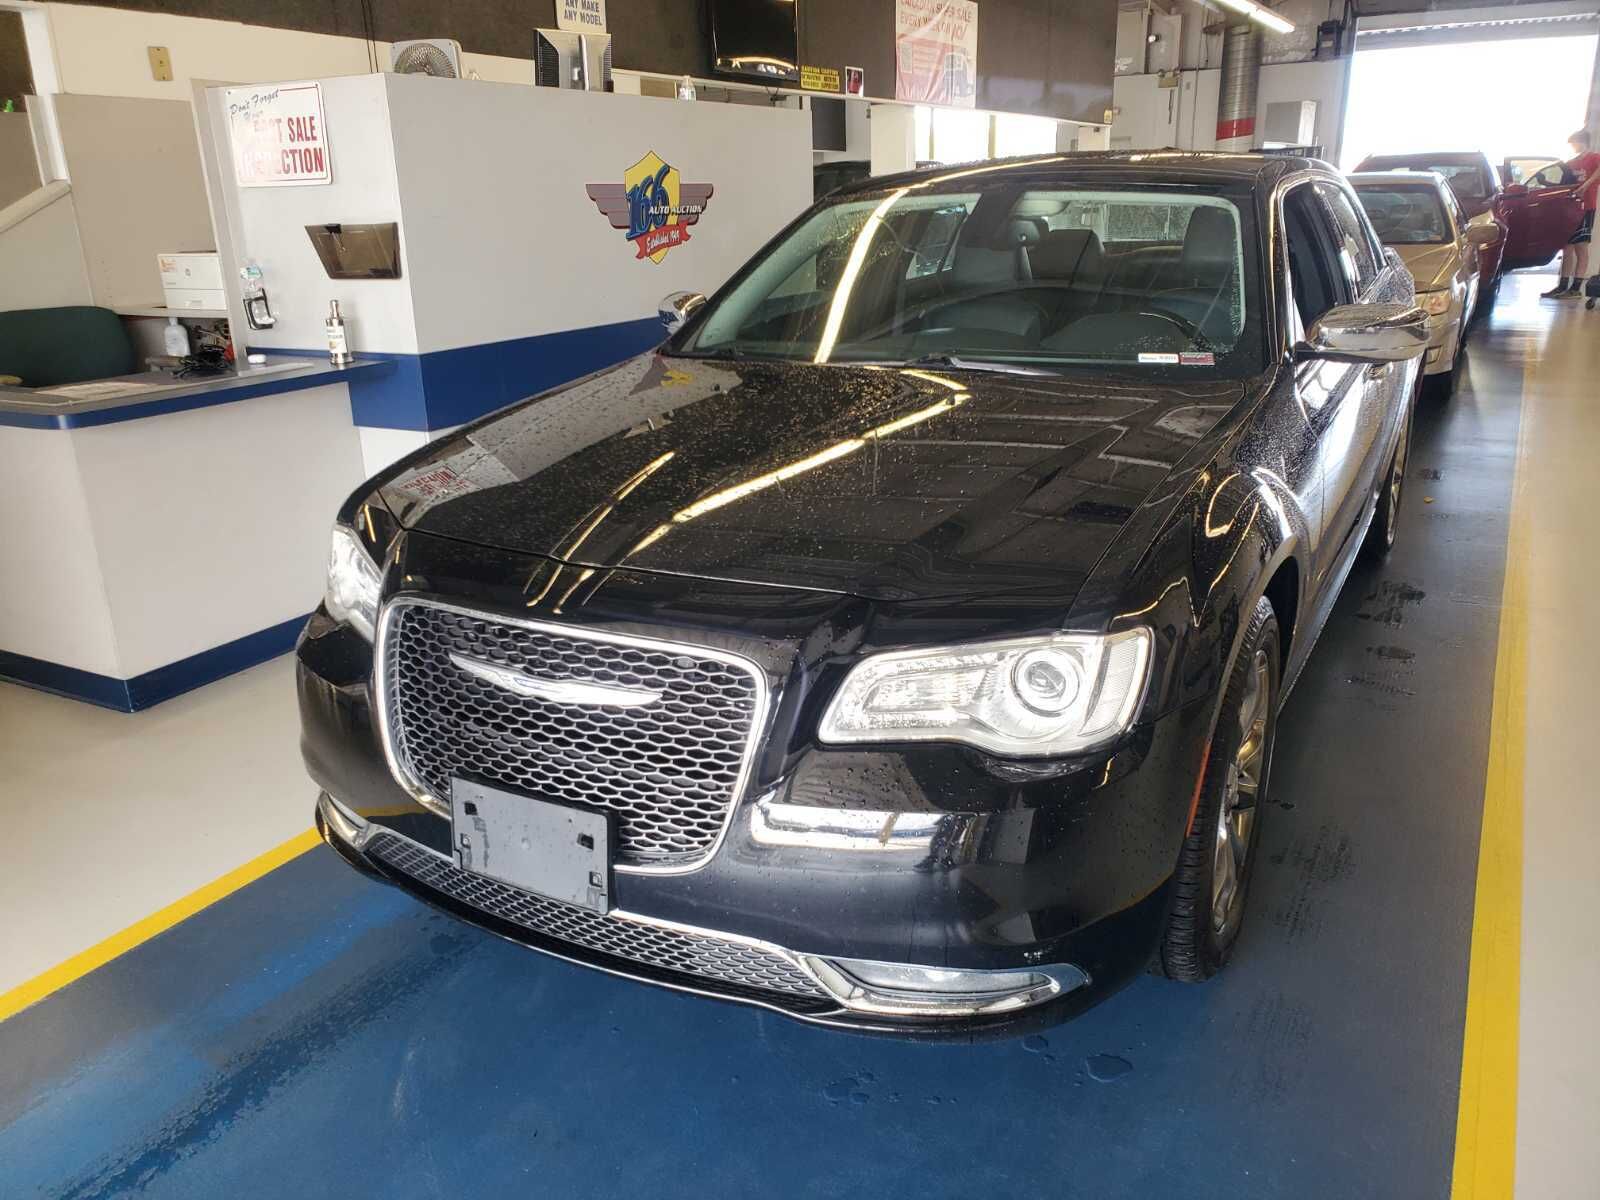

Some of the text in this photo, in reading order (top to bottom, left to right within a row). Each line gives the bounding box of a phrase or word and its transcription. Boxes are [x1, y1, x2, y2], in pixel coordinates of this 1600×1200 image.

[565, 0, 600, 13] ANY MAKE
[564, 9, 603, 26] ANY MODEL
[251, 88, 279, 108] Forget
[287, 116, 318, 142] SALE
[625, 163, 671, 241] 166
[649, 204, 702, 216] AUTO AUCTION
